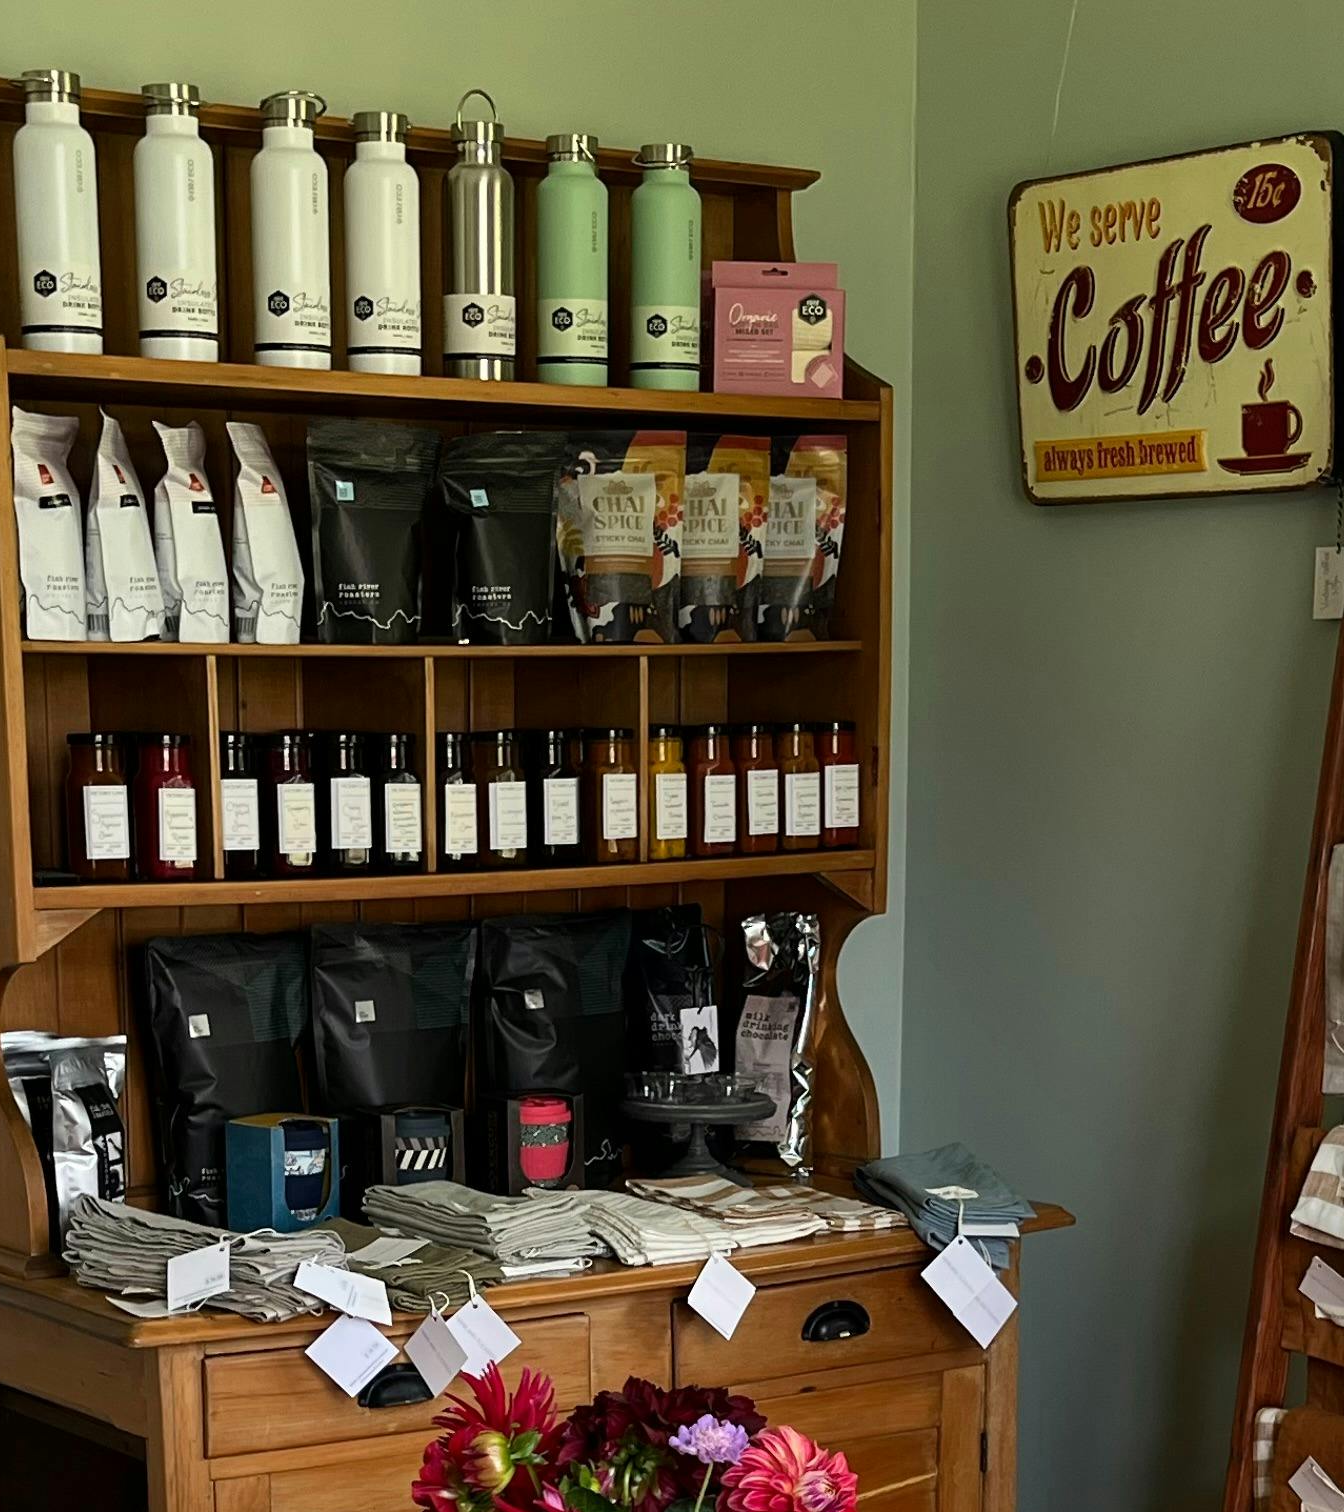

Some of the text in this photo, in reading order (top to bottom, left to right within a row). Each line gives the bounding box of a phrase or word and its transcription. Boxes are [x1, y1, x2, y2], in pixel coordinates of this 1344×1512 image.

[1038, 196, 1162, 253] We serve
[36, 281, 55, 290] ECO
[148, 287, 165, 296] ECO
[270, 301, 287, 310] ECO
[355, 306, 371, 314] ECO
[802, 305, 824, 316] ECO
[464, 312, 483, 321] ECO
[554, 316, 571, 325] ECO
[1047, 224, 1293, 416] Coffee
[649, 322, 665, 331] ECO
[1043, 436, 1197, 475] always fresh brewed
[592, 495, 645, 513] CHAI
[684, 498, 727, 516] HAI
[768, 501, 804, 518] HAI
[594, 514, 644, 530] SPICE
[768, 520, 803, 535] PICE
[338, 591, 380, 599] roasters
[745, 1012, 771, 1021] milk
[742, 1020, 790, 1032] drinking
[740, 1030, 789, 1041] chocolate
